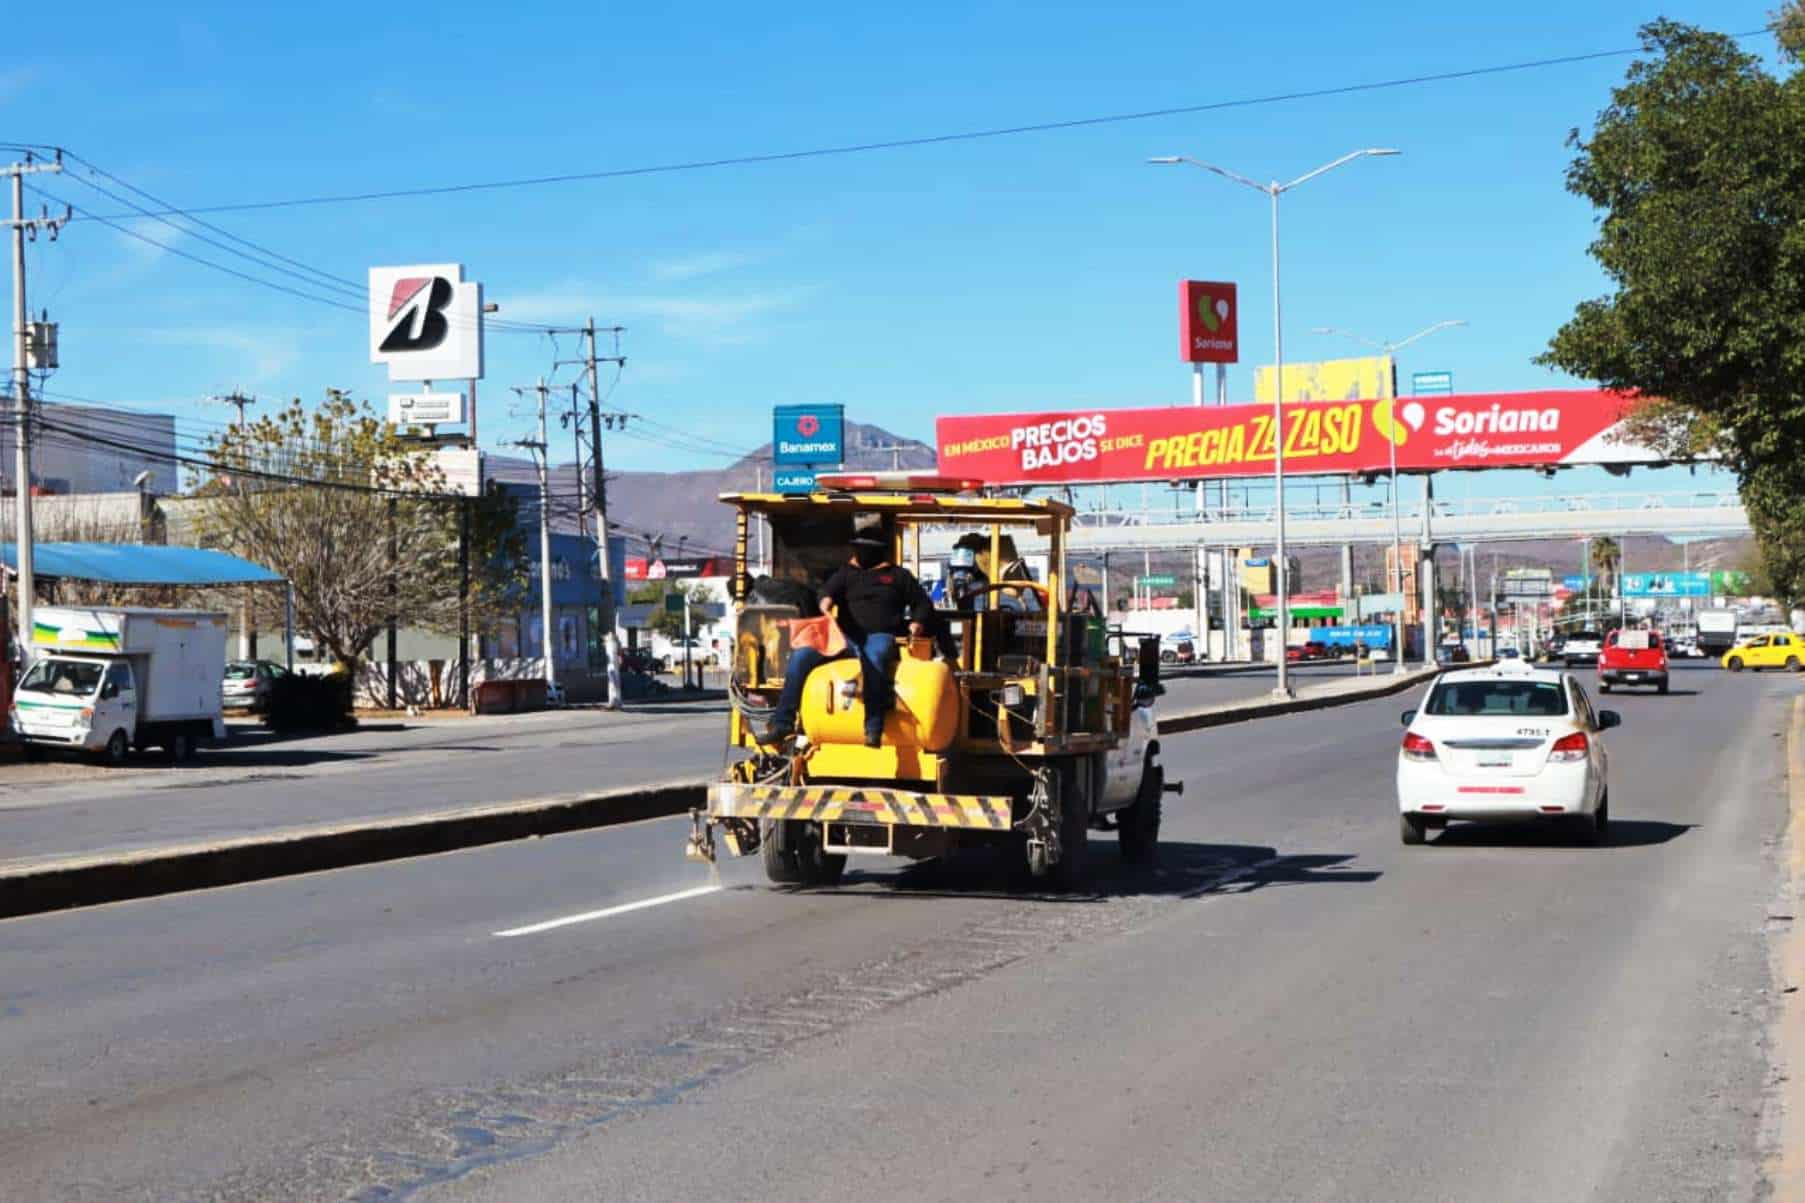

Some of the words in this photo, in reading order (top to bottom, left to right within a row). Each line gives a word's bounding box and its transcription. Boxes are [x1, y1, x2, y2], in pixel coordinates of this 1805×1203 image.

[1194, 336, 1233, 350] Soriana
[1433, 403, 1560, 436] Soriana
[1011, 414, 1107, 449] PRECIOS
[780, 441, 837, 454] Banamex
[1117, 434, 1144, 449] DICE
[944, 443, 960, 457] EN
[1022, 438, 1098, 471] BAJOS
